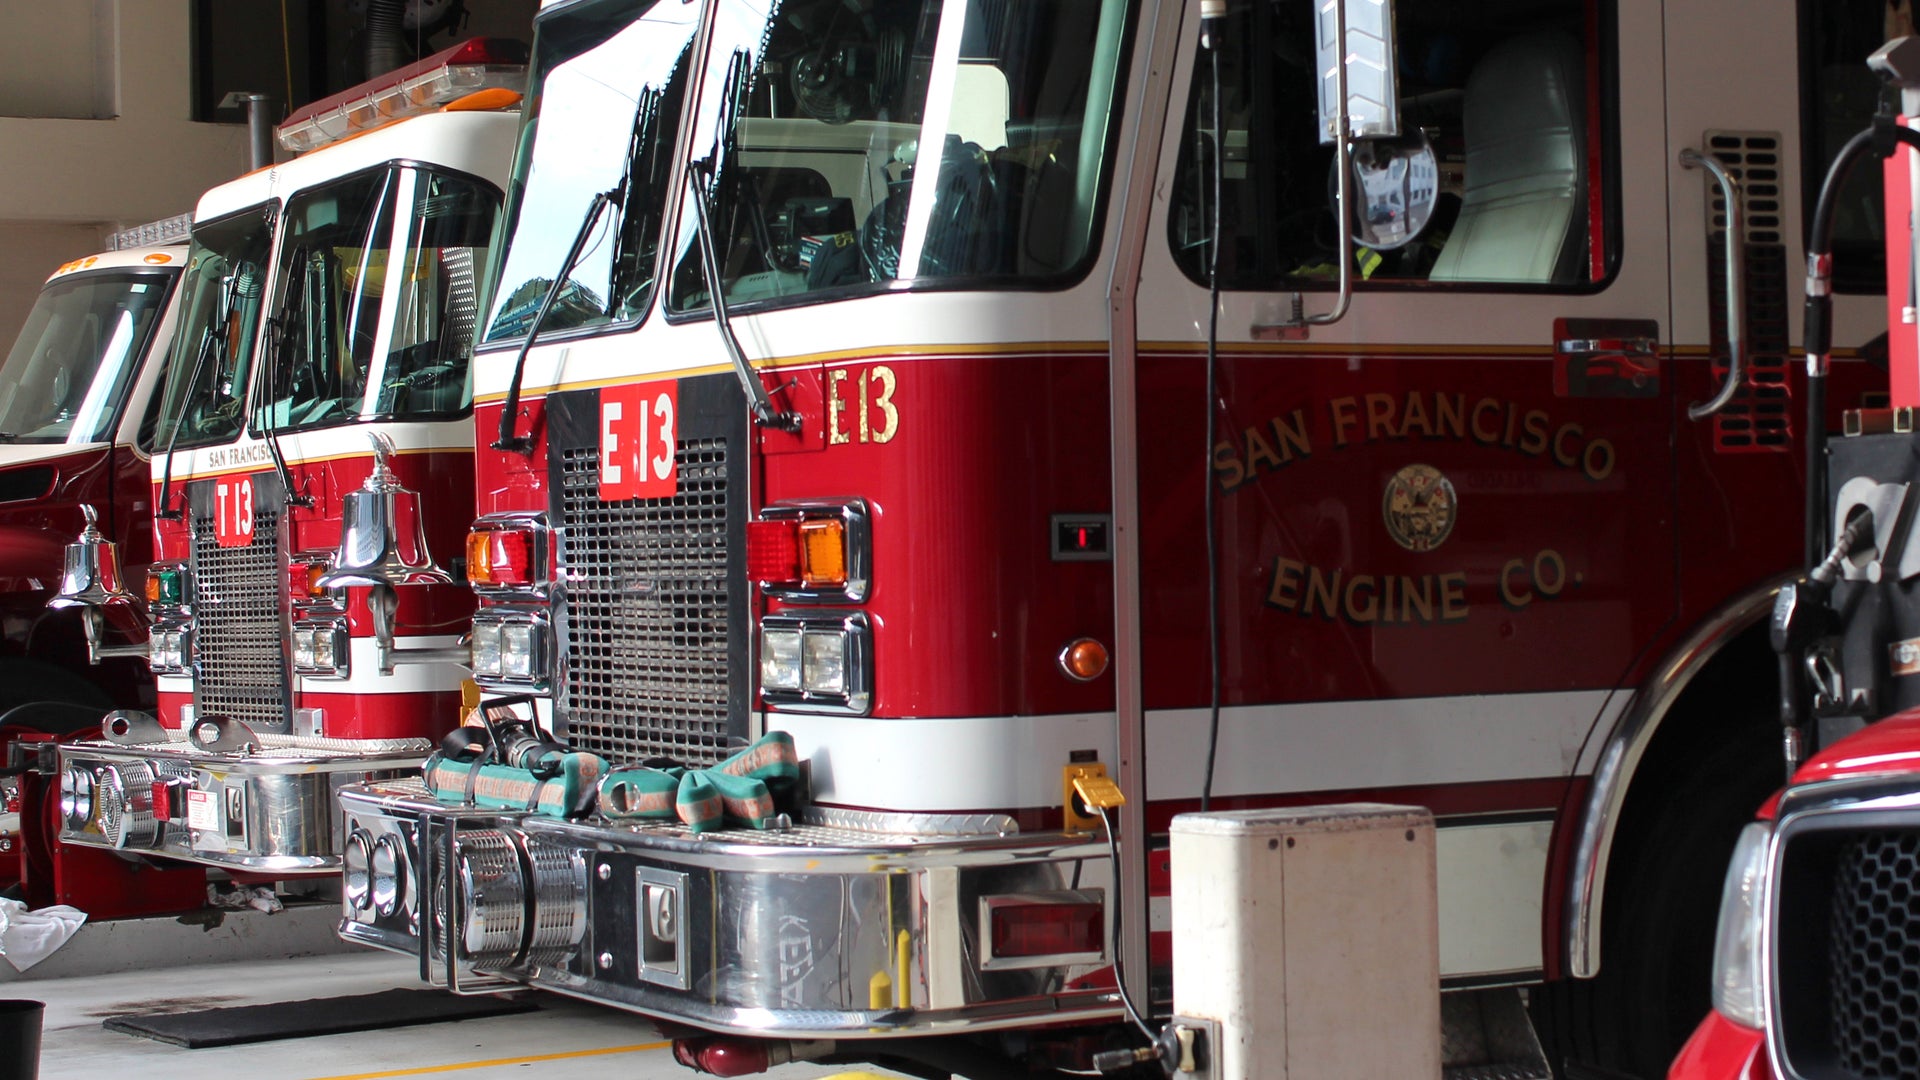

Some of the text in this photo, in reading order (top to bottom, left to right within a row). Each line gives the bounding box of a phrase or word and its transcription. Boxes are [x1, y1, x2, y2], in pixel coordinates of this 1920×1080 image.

[209, 443, 273, 468] SAN FRANCISC
[1212, 391, 1616, 490] SAN FRANCISCO
[1266, 549, 1584, 624] ENGINE CO.
